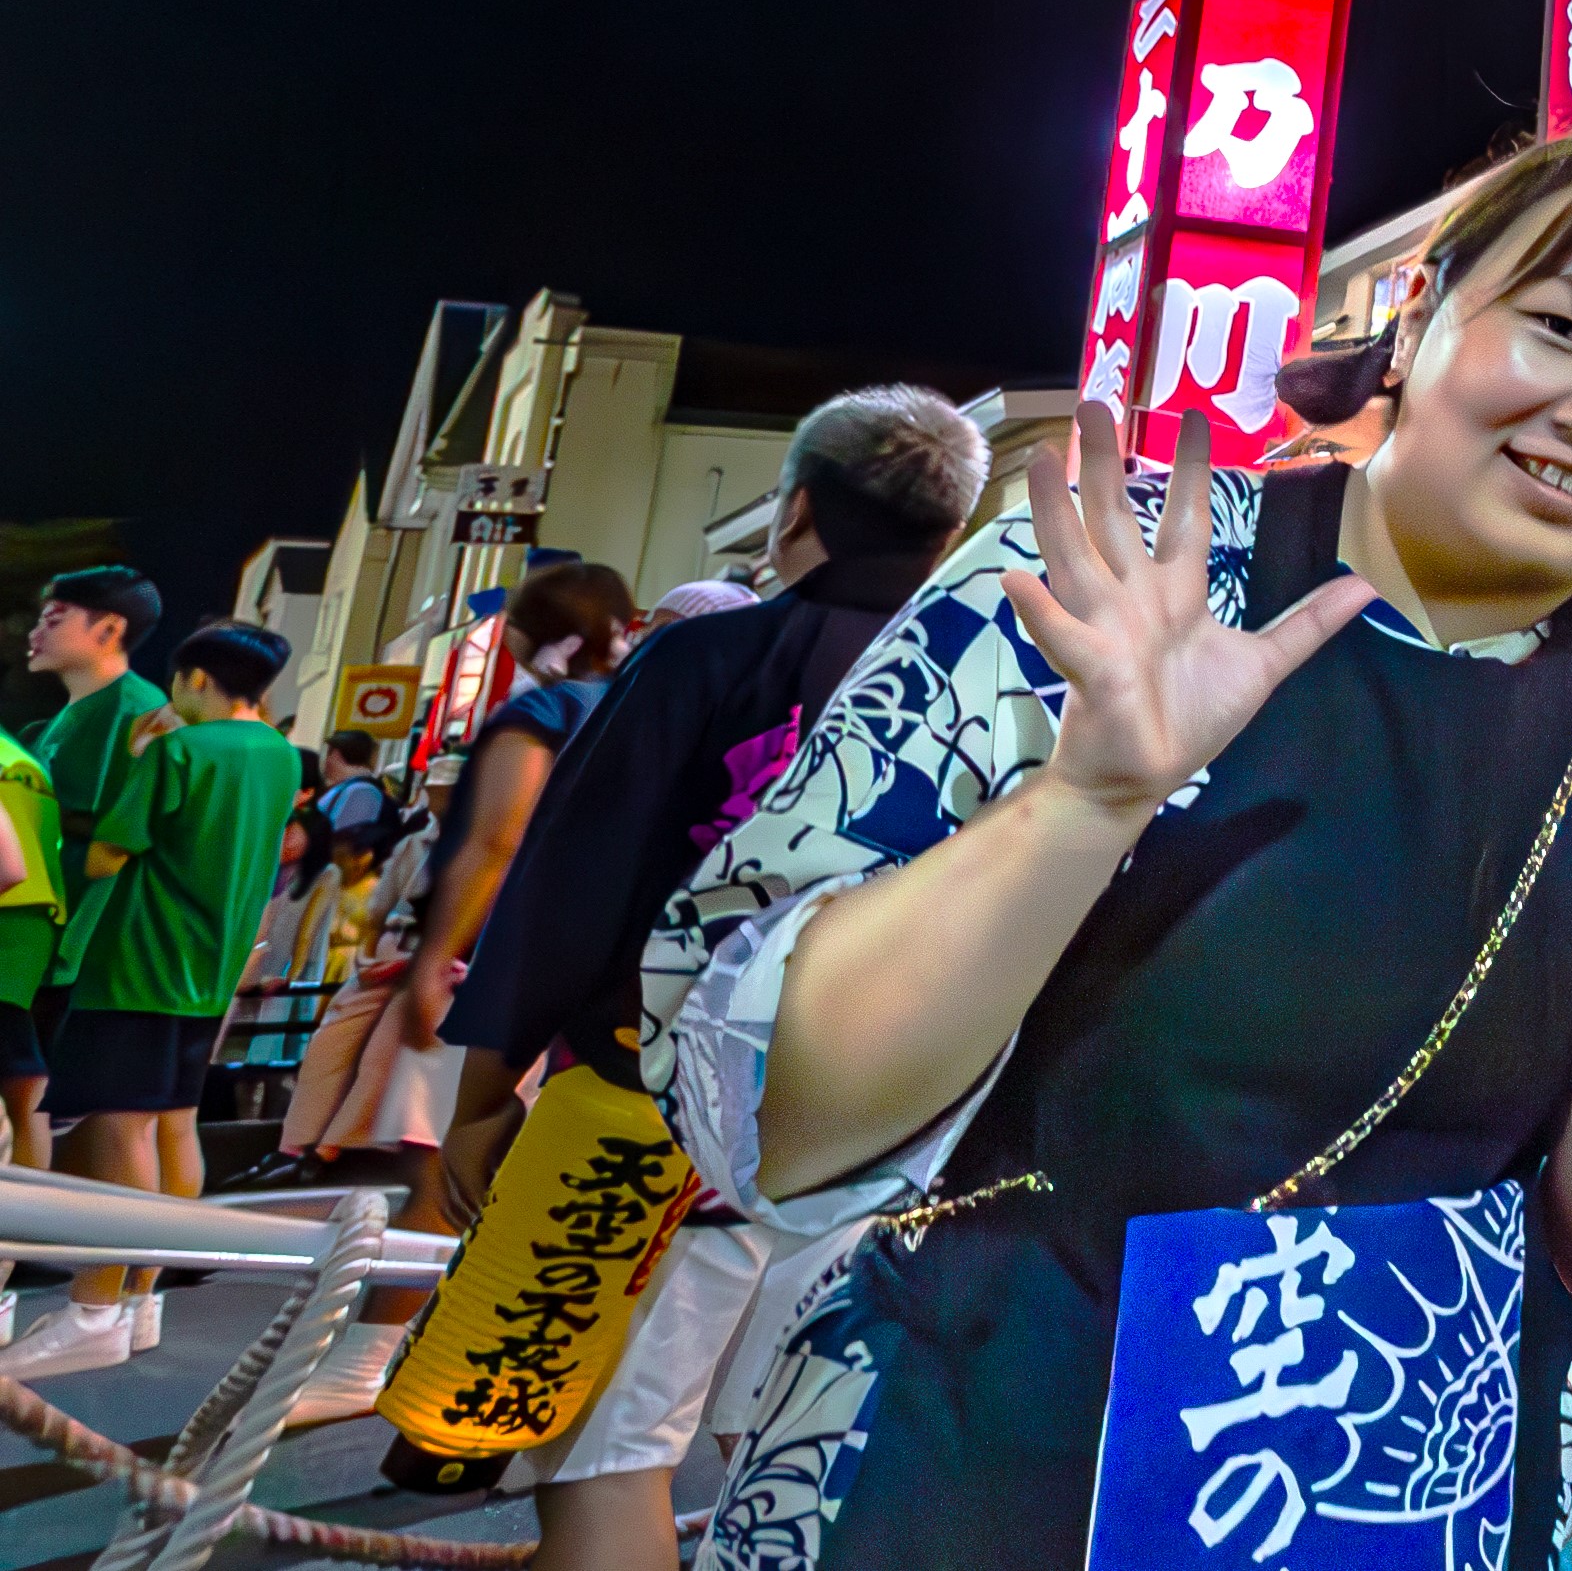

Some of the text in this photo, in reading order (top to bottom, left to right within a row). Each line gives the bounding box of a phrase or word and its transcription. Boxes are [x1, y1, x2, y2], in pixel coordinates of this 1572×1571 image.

[442, 1137, 679, 1436] 天空の不夜城
